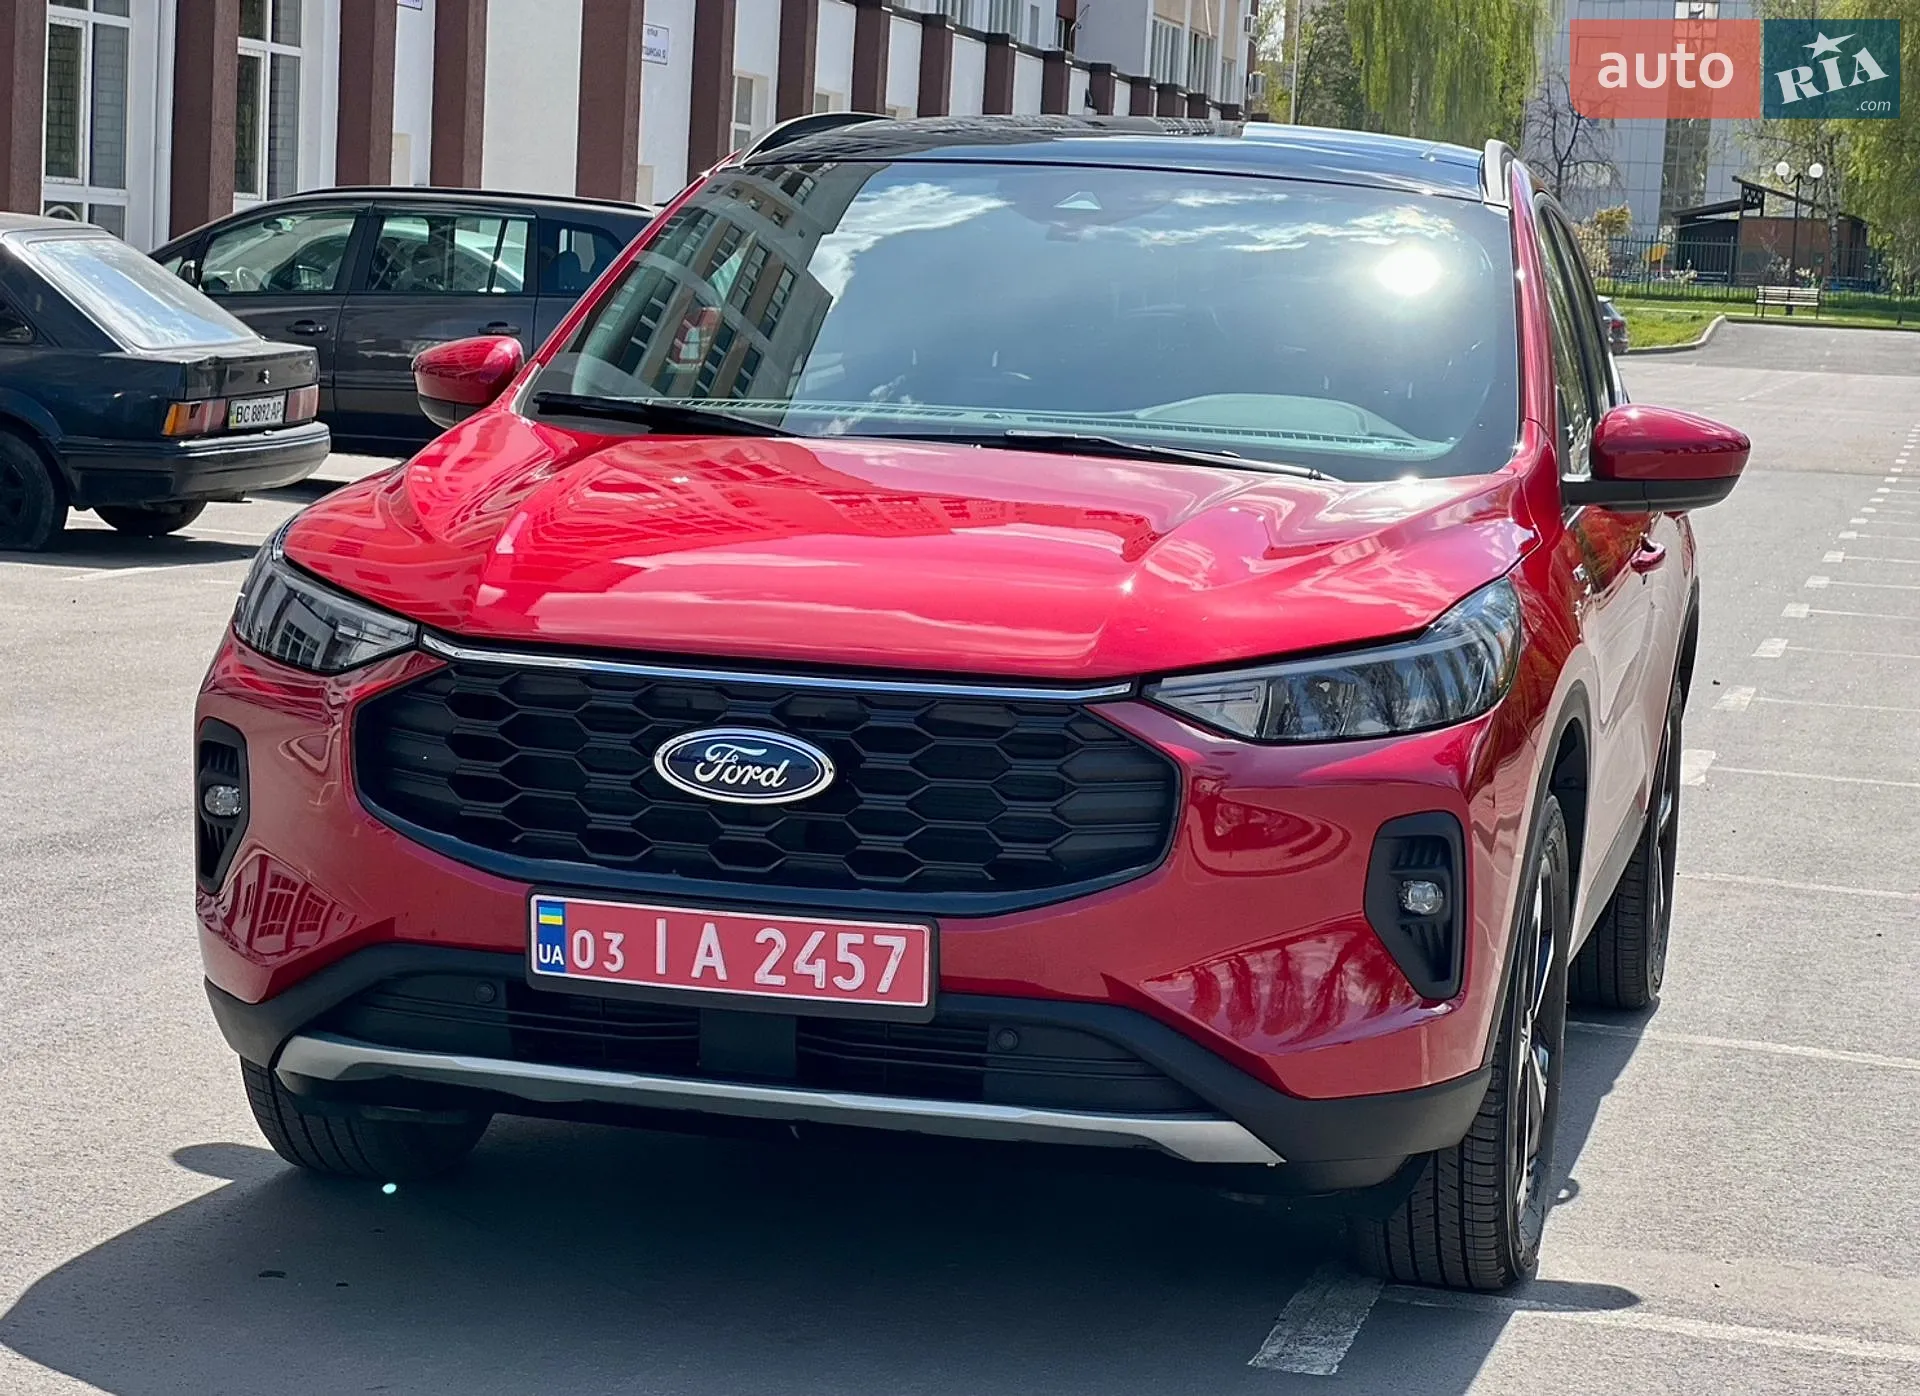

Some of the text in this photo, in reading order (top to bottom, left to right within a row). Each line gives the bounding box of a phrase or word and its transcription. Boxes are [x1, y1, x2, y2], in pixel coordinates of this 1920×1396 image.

[235, 404, 250, 424] BC
[694, 743, 791, 788] Ford
[538, 943, 565, 966] UA
[571, 928, 625, 973] 03
[754, 927, 908, 993] 2457
